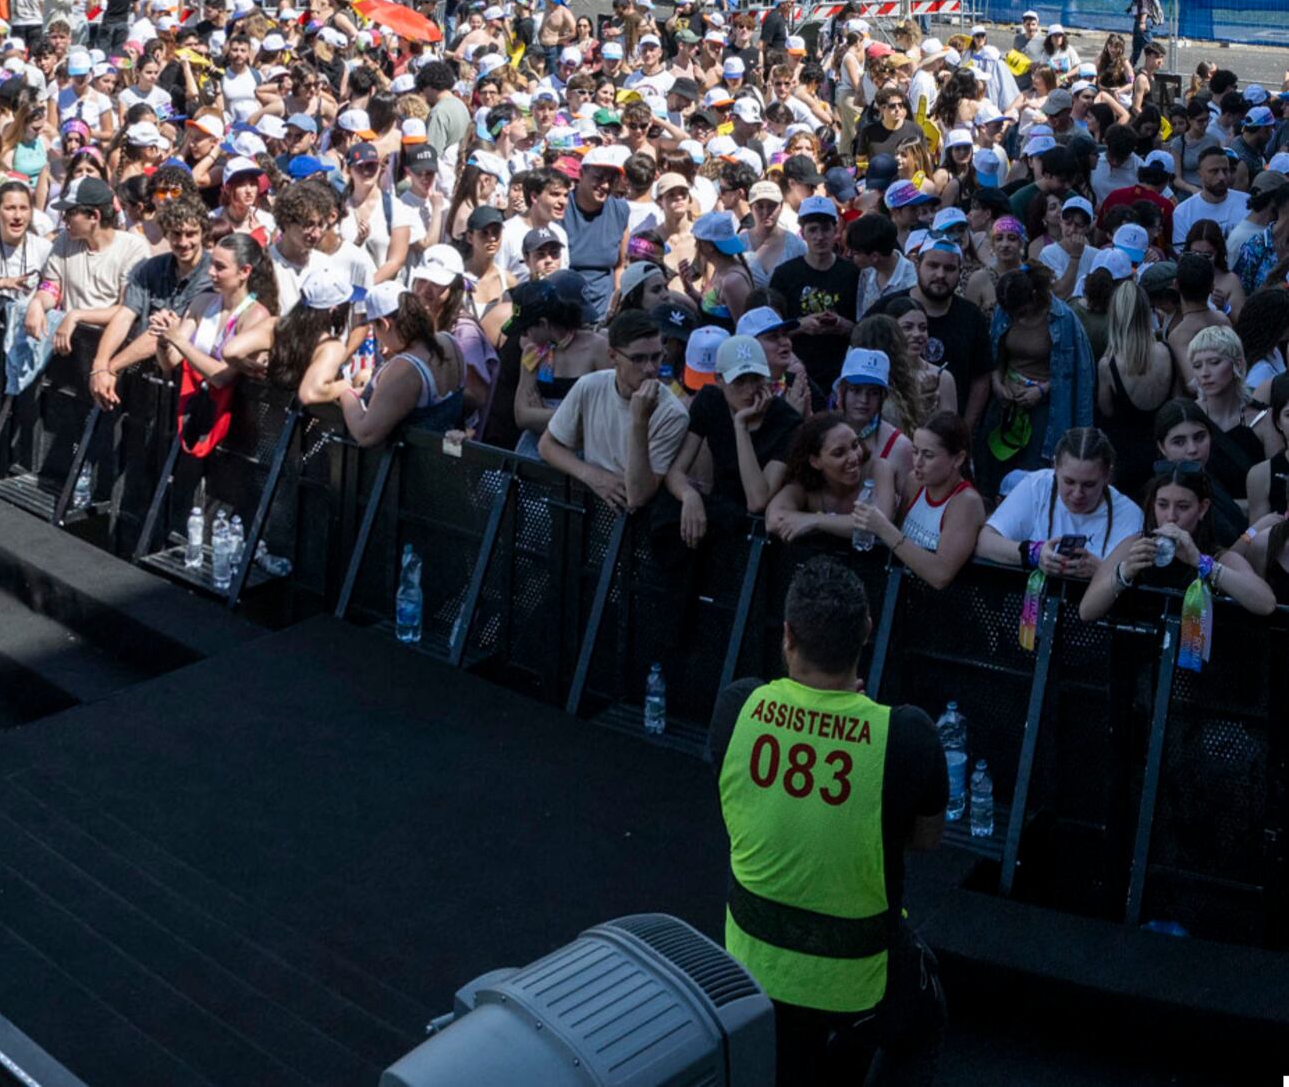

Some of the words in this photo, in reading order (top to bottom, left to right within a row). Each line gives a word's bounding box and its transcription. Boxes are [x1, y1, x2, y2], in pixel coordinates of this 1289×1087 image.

[736, 344, 752, 361] NY
[750, 699, 871, 745] ASSISTENZA
[749, 733, 853, 806] 083
